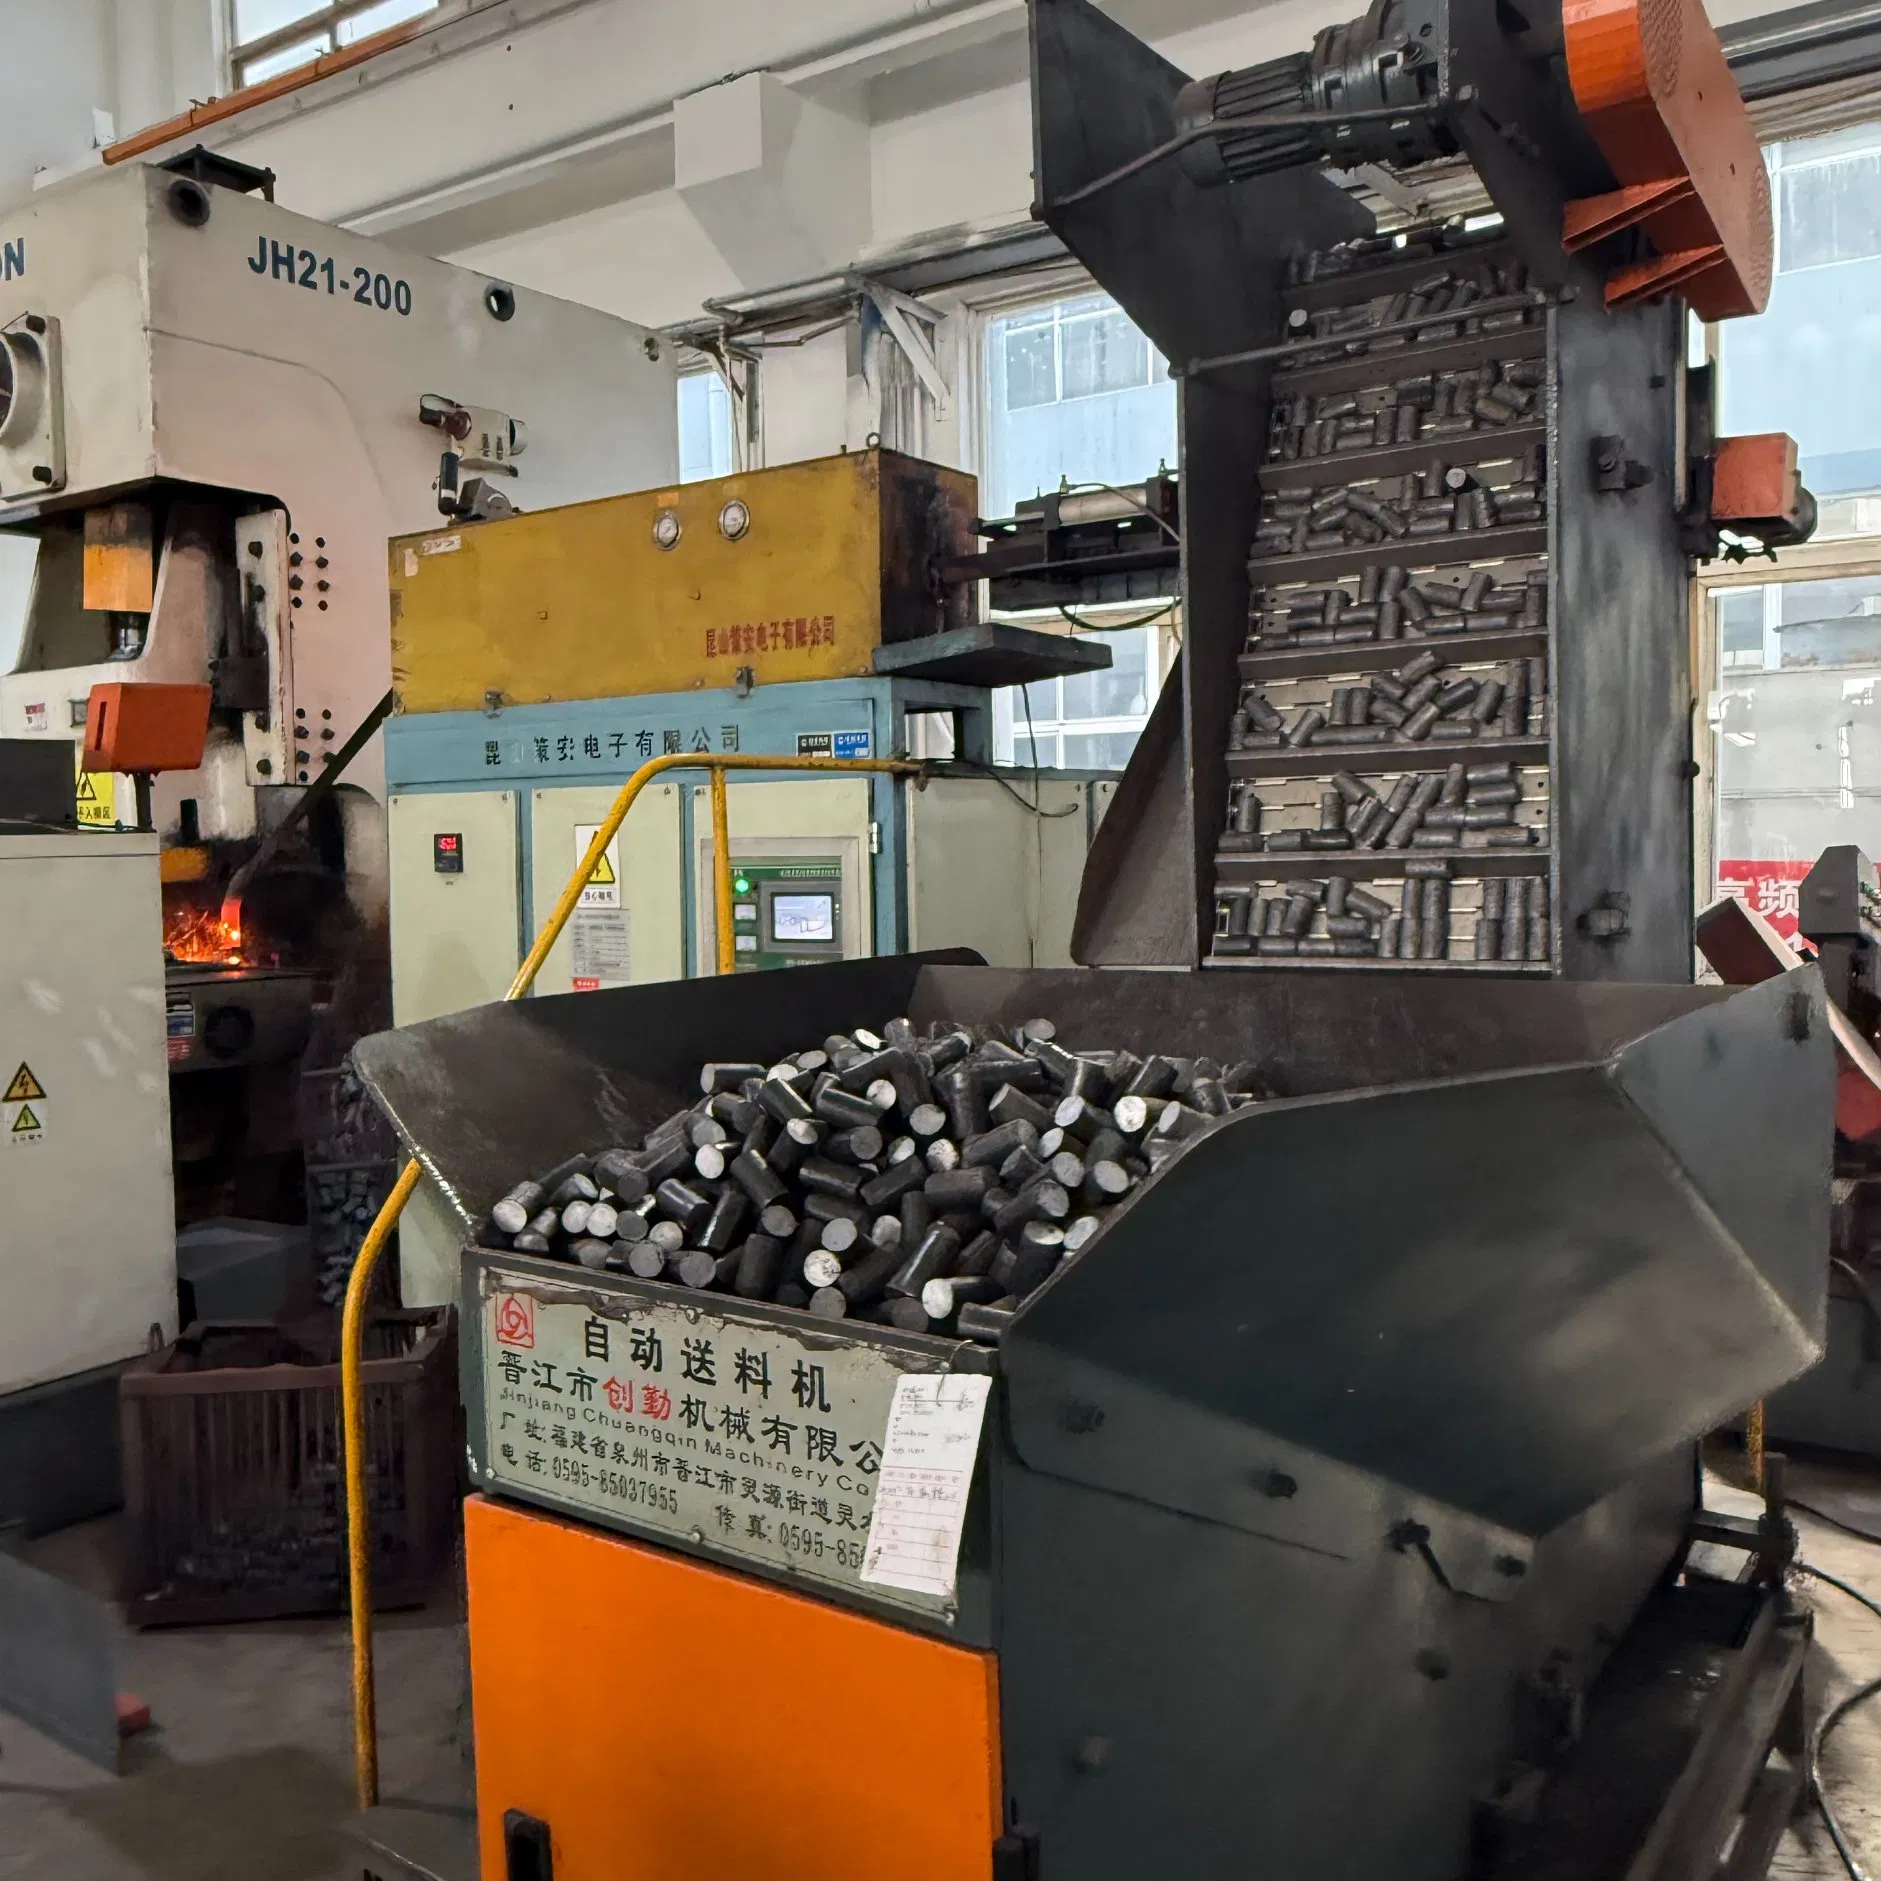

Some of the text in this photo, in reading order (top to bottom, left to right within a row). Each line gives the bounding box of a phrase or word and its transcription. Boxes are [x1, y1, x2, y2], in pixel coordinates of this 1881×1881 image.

[248, 236, 411, 316] JH21-200
[585, 1315, 832, 1413] 自动送料机
[583, 1407, 697, 1449] Chuangqin
